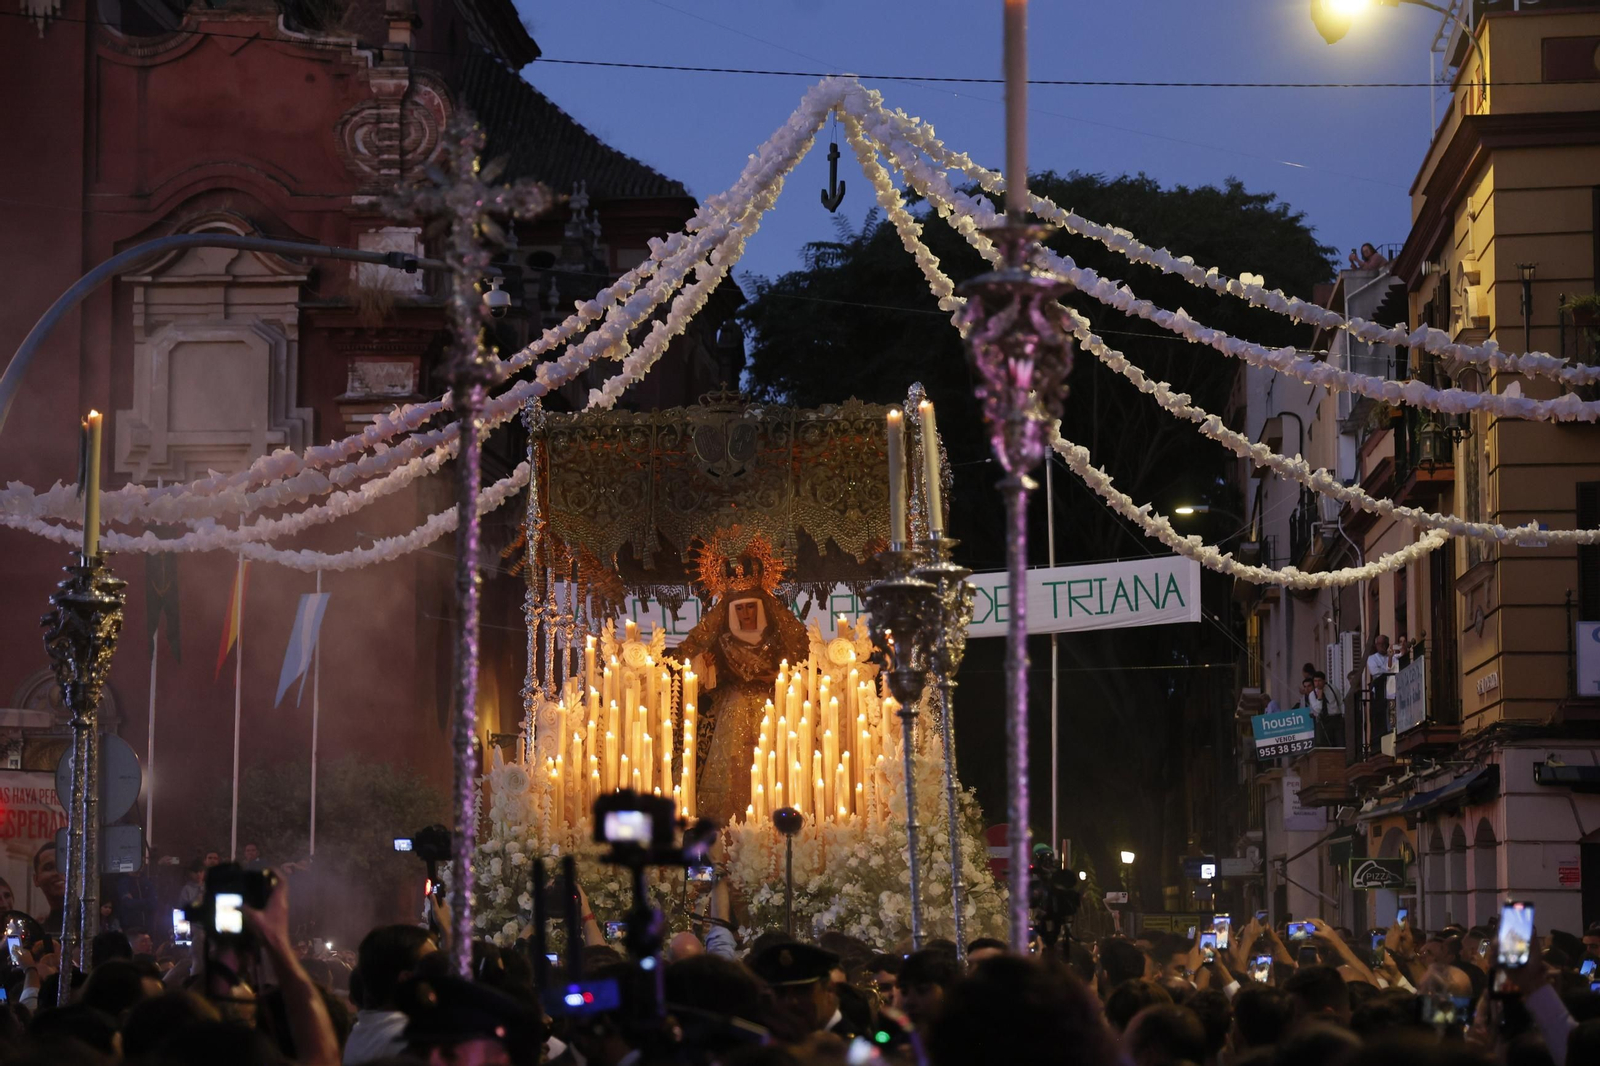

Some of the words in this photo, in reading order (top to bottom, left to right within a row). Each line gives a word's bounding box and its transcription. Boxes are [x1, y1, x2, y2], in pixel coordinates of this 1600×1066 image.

[1042, 572, 1186, 619] TRIANA
[1261, 712, 1304, 730] housin
[1275, 735, 1296, 743] VENDE
[1259, 747, 1276, 757] 955
[1278, 744, 1289, 754] 38
[1291, 742, 1302, 752] 55
[1303, 740, 1313, 750] 22
[0, 787, 10, 804] AS
[13, 788, 37, 804] HAYA
[39, 789, 61, 806] PER
[0, 809, 69, 839] ESPERAN
[1366, 872, 1391, 880] PIZZA
